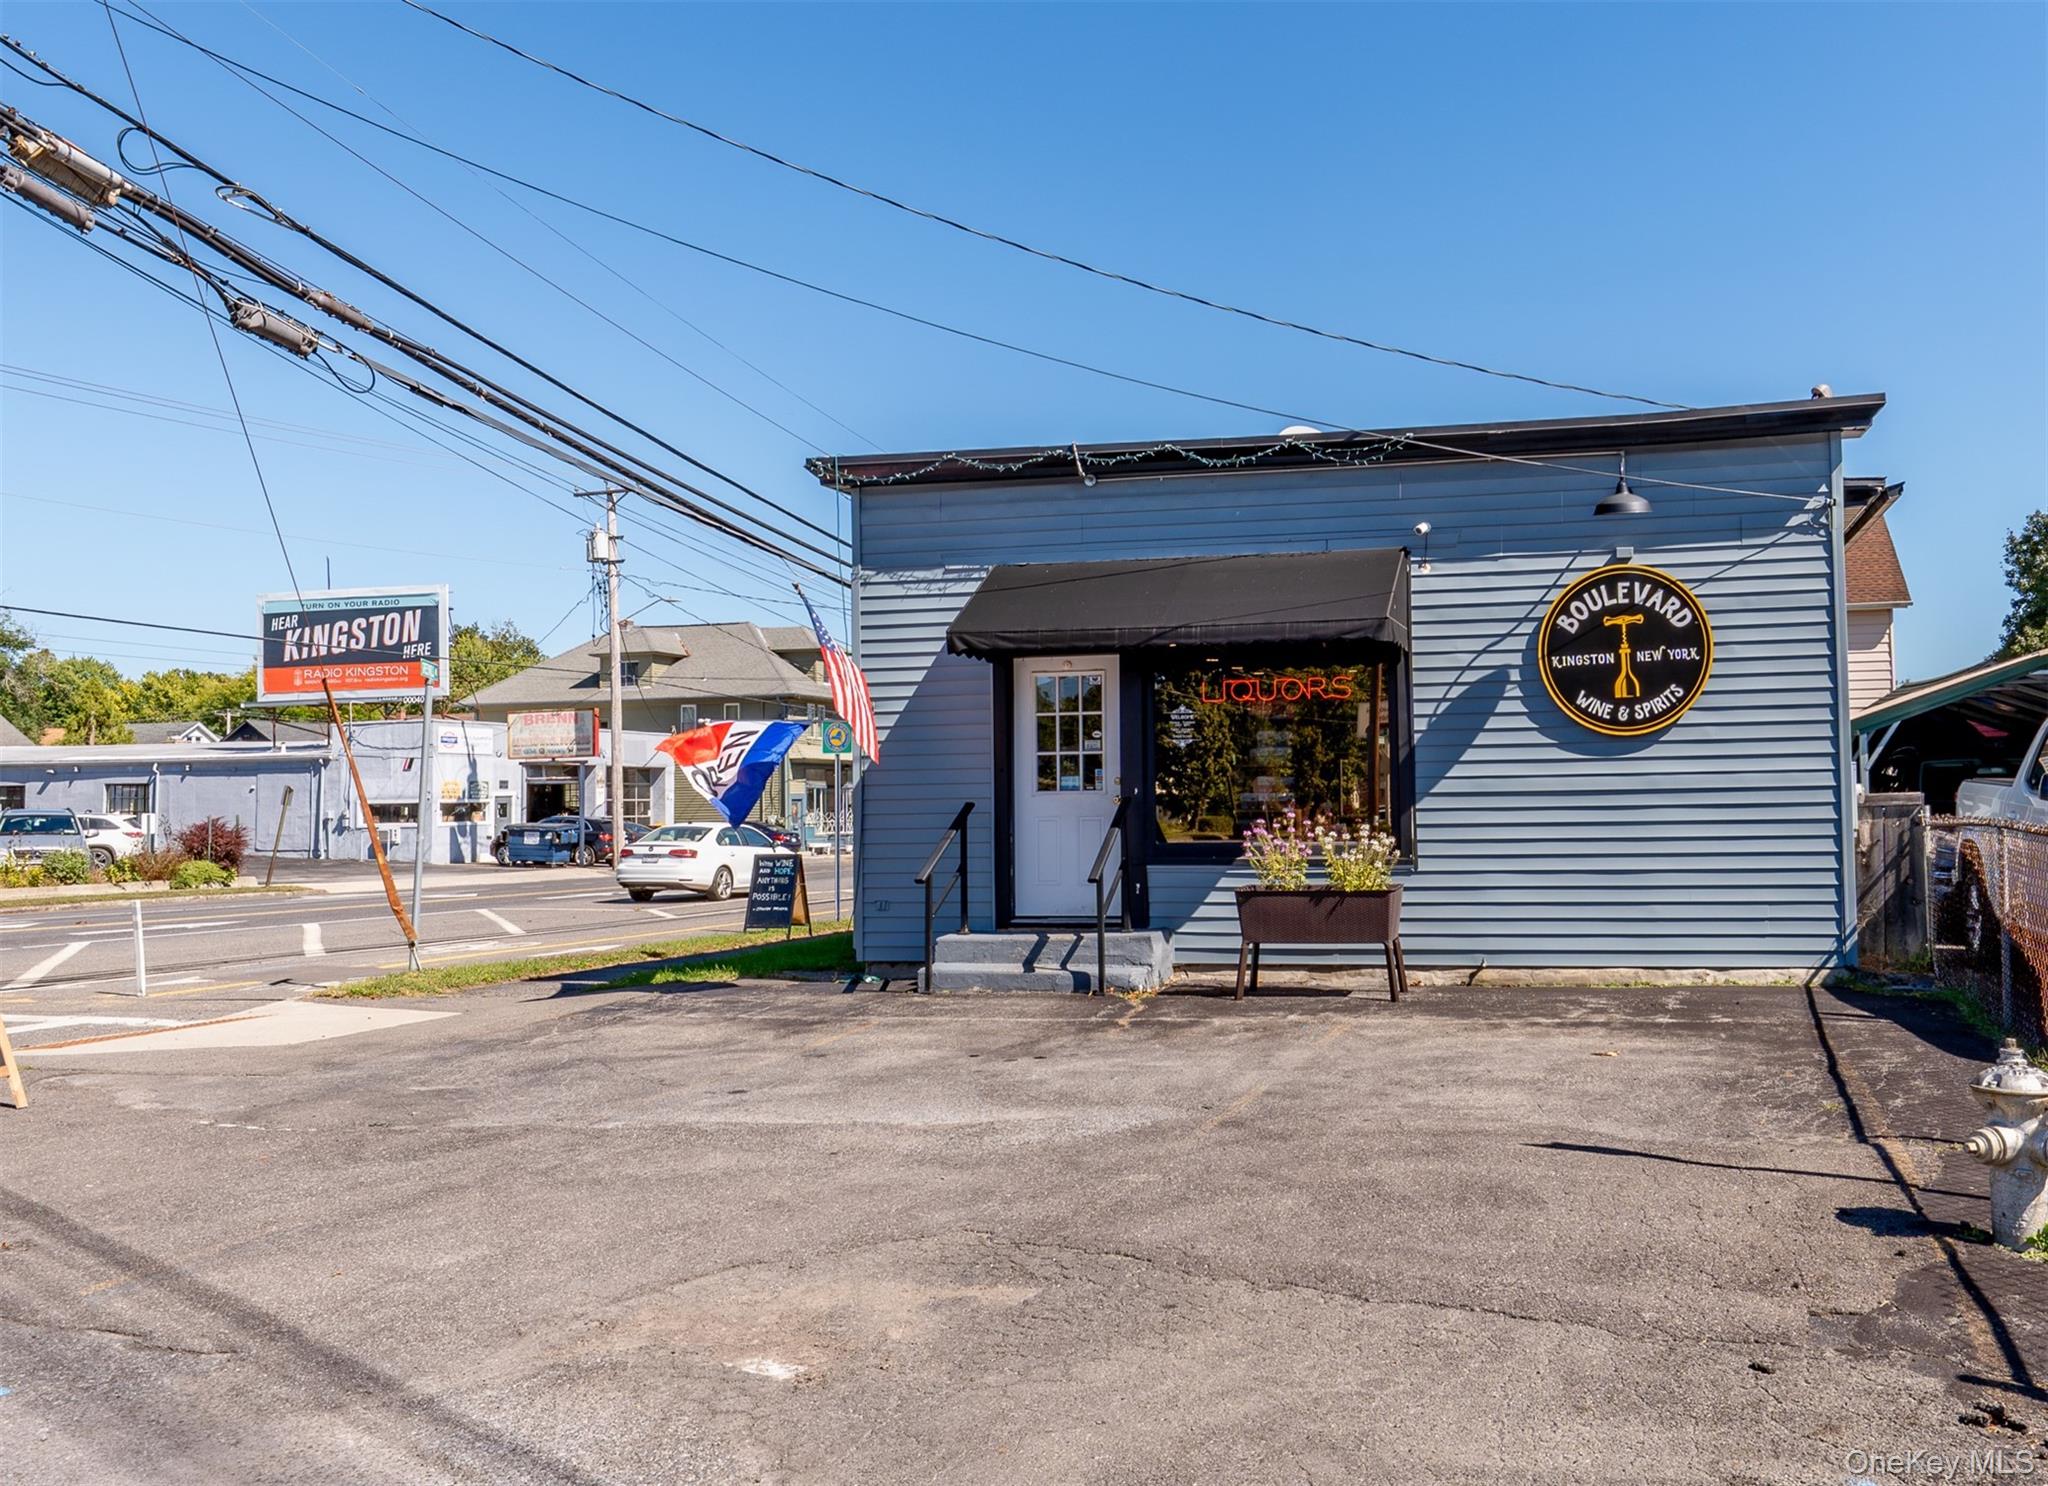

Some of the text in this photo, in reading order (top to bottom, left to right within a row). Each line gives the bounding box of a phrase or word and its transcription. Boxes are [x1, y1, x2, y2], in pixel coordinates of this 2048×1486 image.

[328, 601, 340, 609] ON
[344, 600, 368, 608] YOUR
[372, 598, 400, 606] RADIO
[1556, 581, 1693, 635] BOULEVARD
[271, 614, 298, 632] HEAR
[283, 609, 422, 663] KINGSTON
[402, 642, 432, 659] HERE
[1551, 645, 1700, 669] KINGSTON NEW YORK
[304, 666, 408, 678] RADIO KINGSTON
[1201, 675, 1353, 703] LIQUORS
[1575, 683, 1685, 721] WINE & SPIRITS
[691, 730, 759, 797] OPEN
[775, 859, 794, 867] WINE
